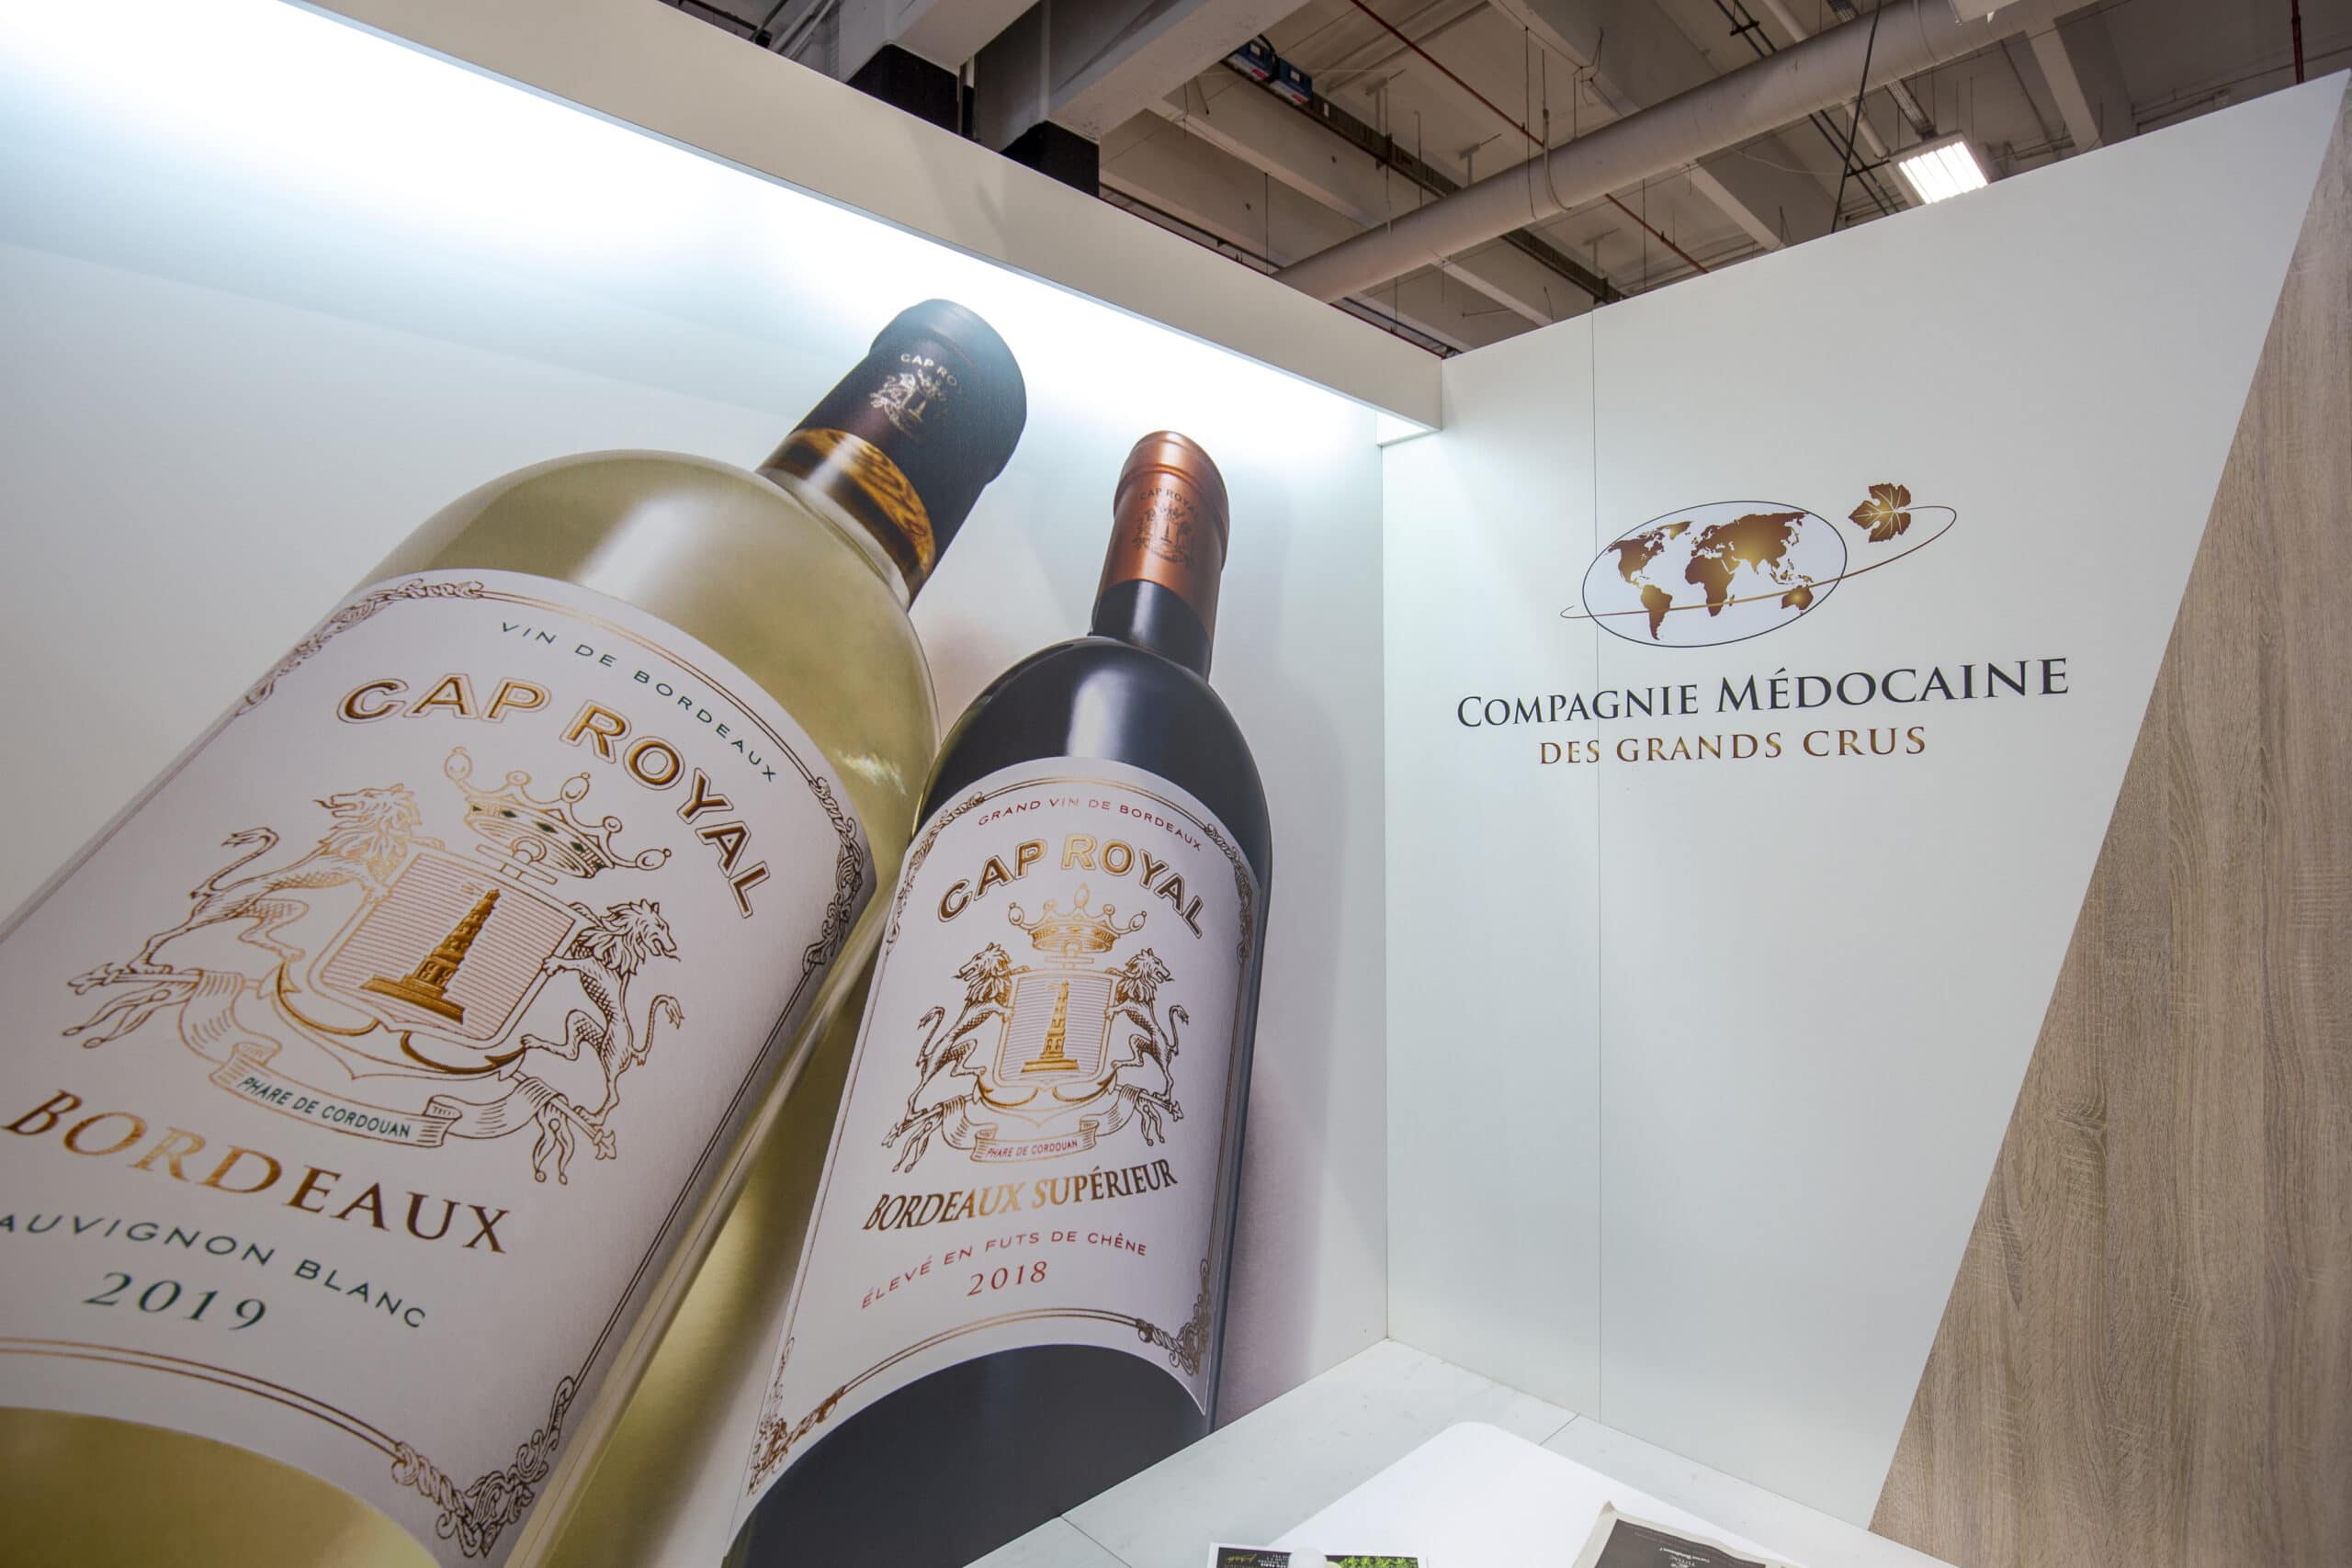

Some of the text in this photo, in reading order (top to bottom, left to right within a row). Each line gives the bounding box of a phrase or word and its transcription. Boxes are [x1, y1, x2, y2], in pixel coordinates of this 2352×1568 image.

[900, 354, 934, 367] CAP
[1140, 487, 1162, 501] CAP
[503, 622, 776, 783] VIN DE BORDEAUX
[1457, 656, 2070, 728] COMPAGNIE MÉDOCAINE
[1539, 725, 1927, 765] DES GRANDS CRUS
[336, 673, 772, 918] CAP ROYAL
[978, 797, 1202, 852] GRAND VIN DE BORDEAUX
[937, 833, 1206, 940] CAP ROYAL
[236, 1077, 411, 1138] PHARE DE CORDOUAN
[1, 1089, 511, 1255] BORDEAUX
[986, 1139, 1078, 1158] PHARE DE CORDOUAN
[862, 1157, 1179, 1231] BORDEAUX SUPÉRIEUR
[83, 1271, 267, 1332] 2019
[293, 1258, 427, 1329] BLANC
[861, 1230, 1148, 1310] ÉLEVÉ EN FUTS DE CHÊNE
[967, 1260, 1048, 1297] 2018
